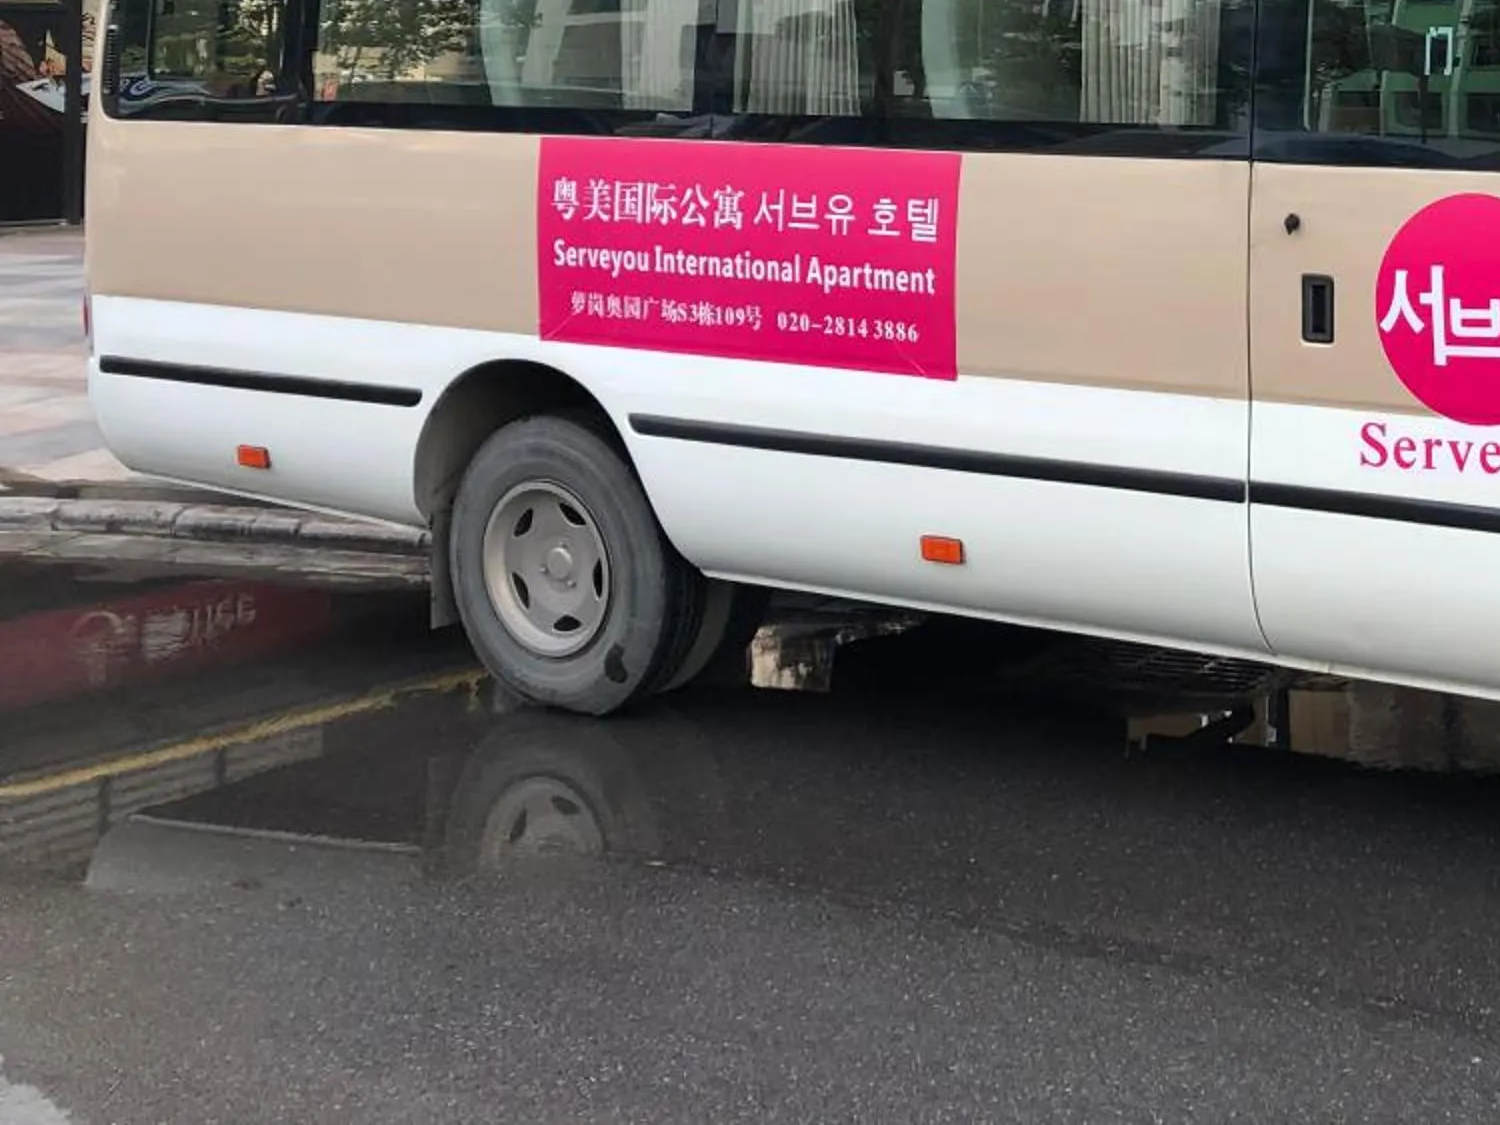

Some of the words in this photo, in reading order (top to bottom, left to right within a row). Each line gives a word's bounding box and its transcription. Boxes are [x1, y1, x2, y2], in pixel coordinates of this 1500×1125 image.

[551, 176, 745, 231] 粤美国际公寓
[753, 189, 856, 236] 서브유
[867, 197, 940, 243] 호텔
[553, 239, 649, 277] Serveyou
[655, 245, 800, 283] International
[806, 256, 936, 295] Apartment
[874, 319, 918, 343] 3886
